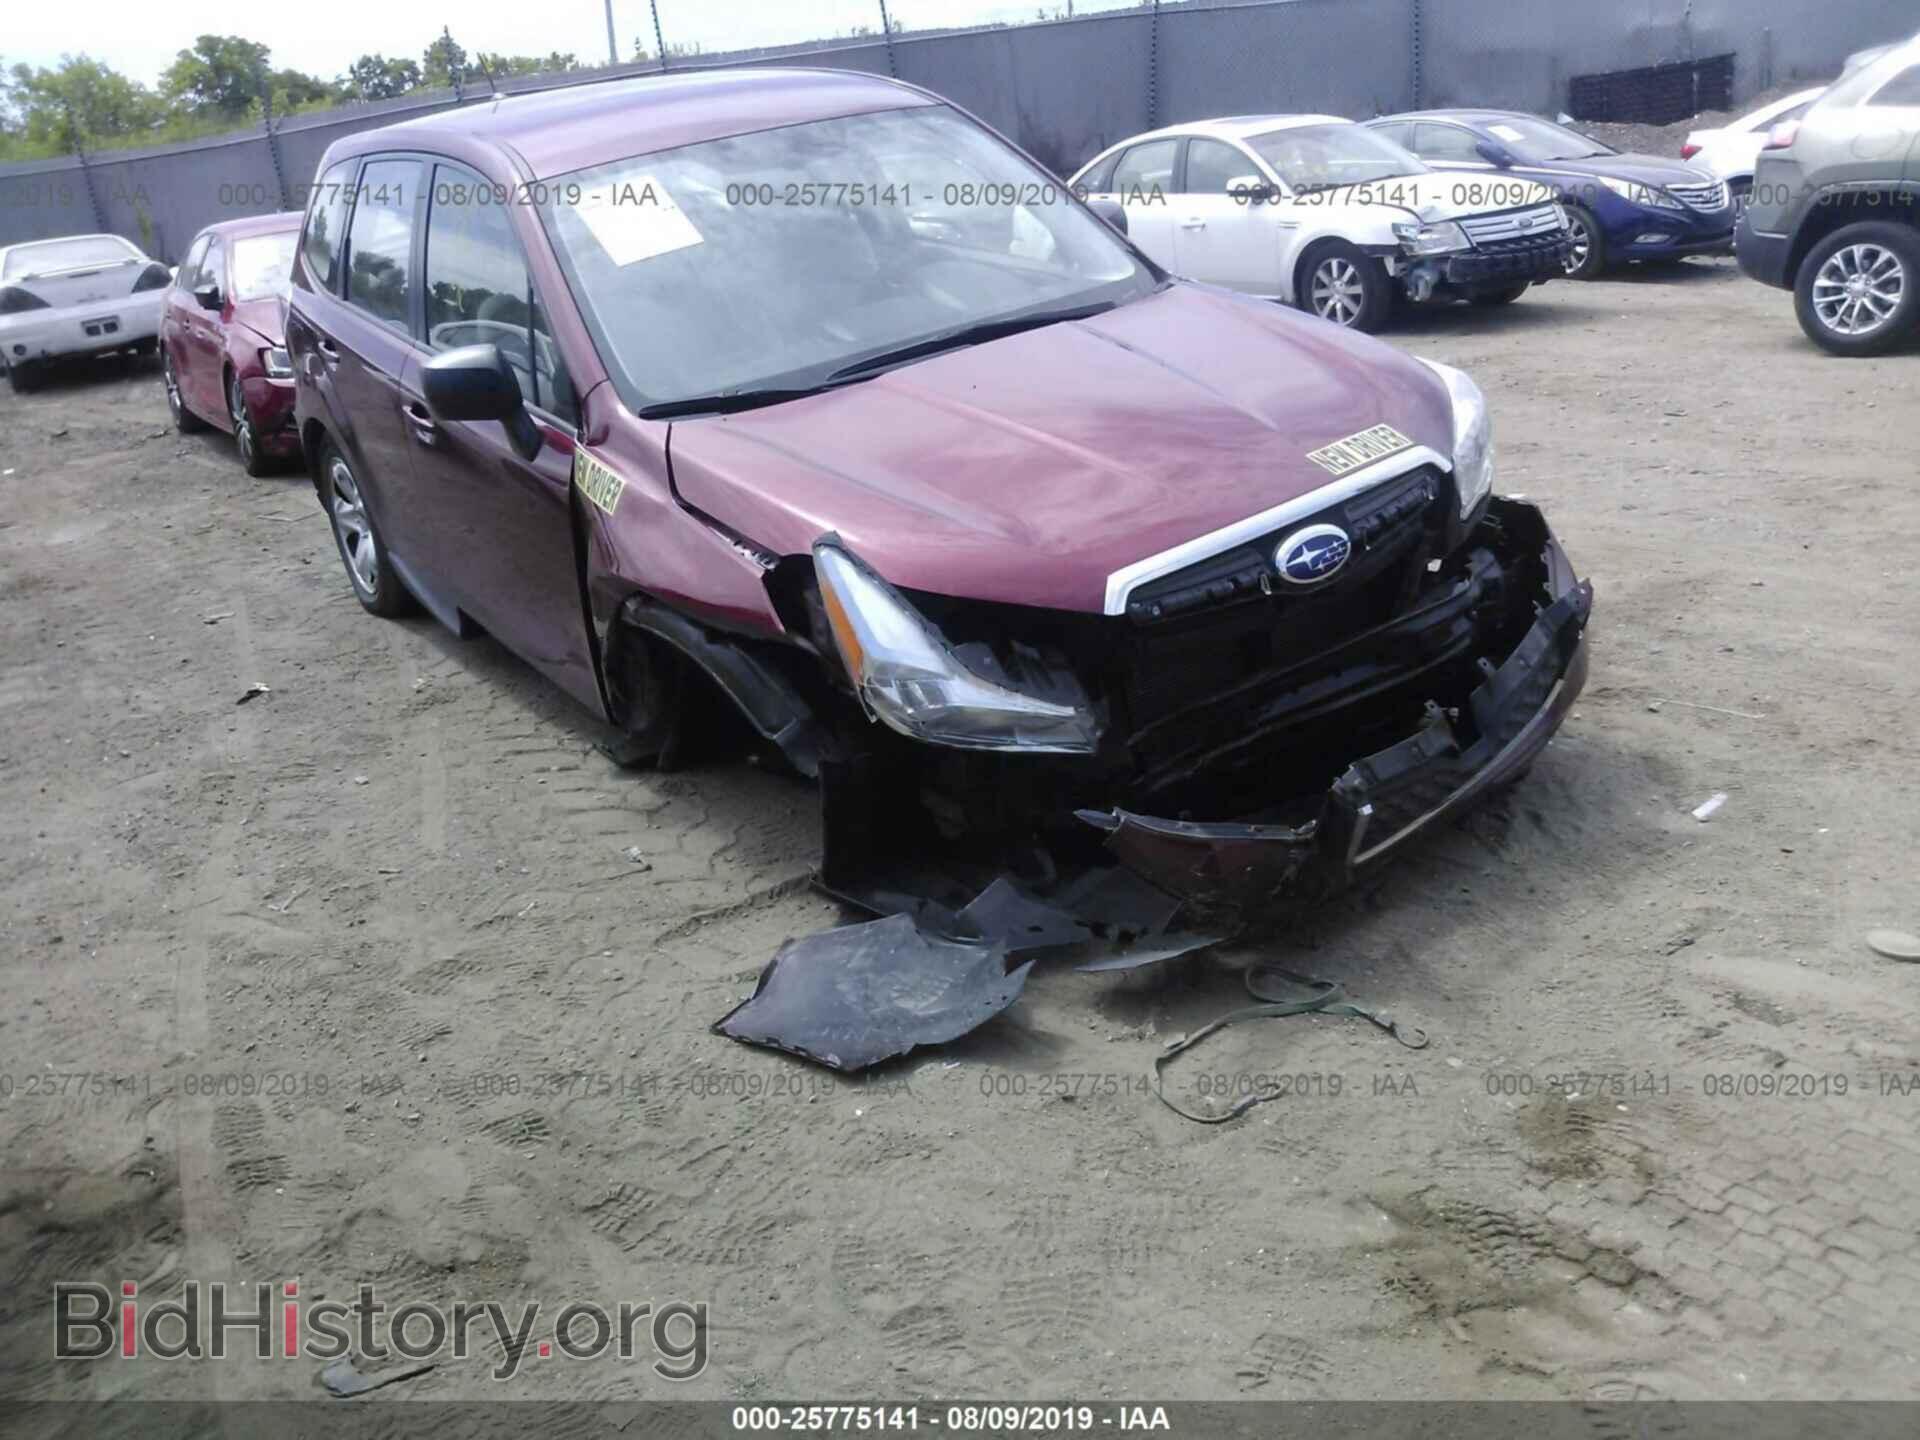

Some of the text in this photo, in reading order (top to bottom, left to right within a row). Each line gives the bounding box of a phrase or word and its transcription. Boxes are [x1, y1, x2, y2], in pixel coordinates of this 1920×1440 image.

[1307, 426, 1410, 474] NEW DRIVER
[586, 461, 622, 512] DRIVER
